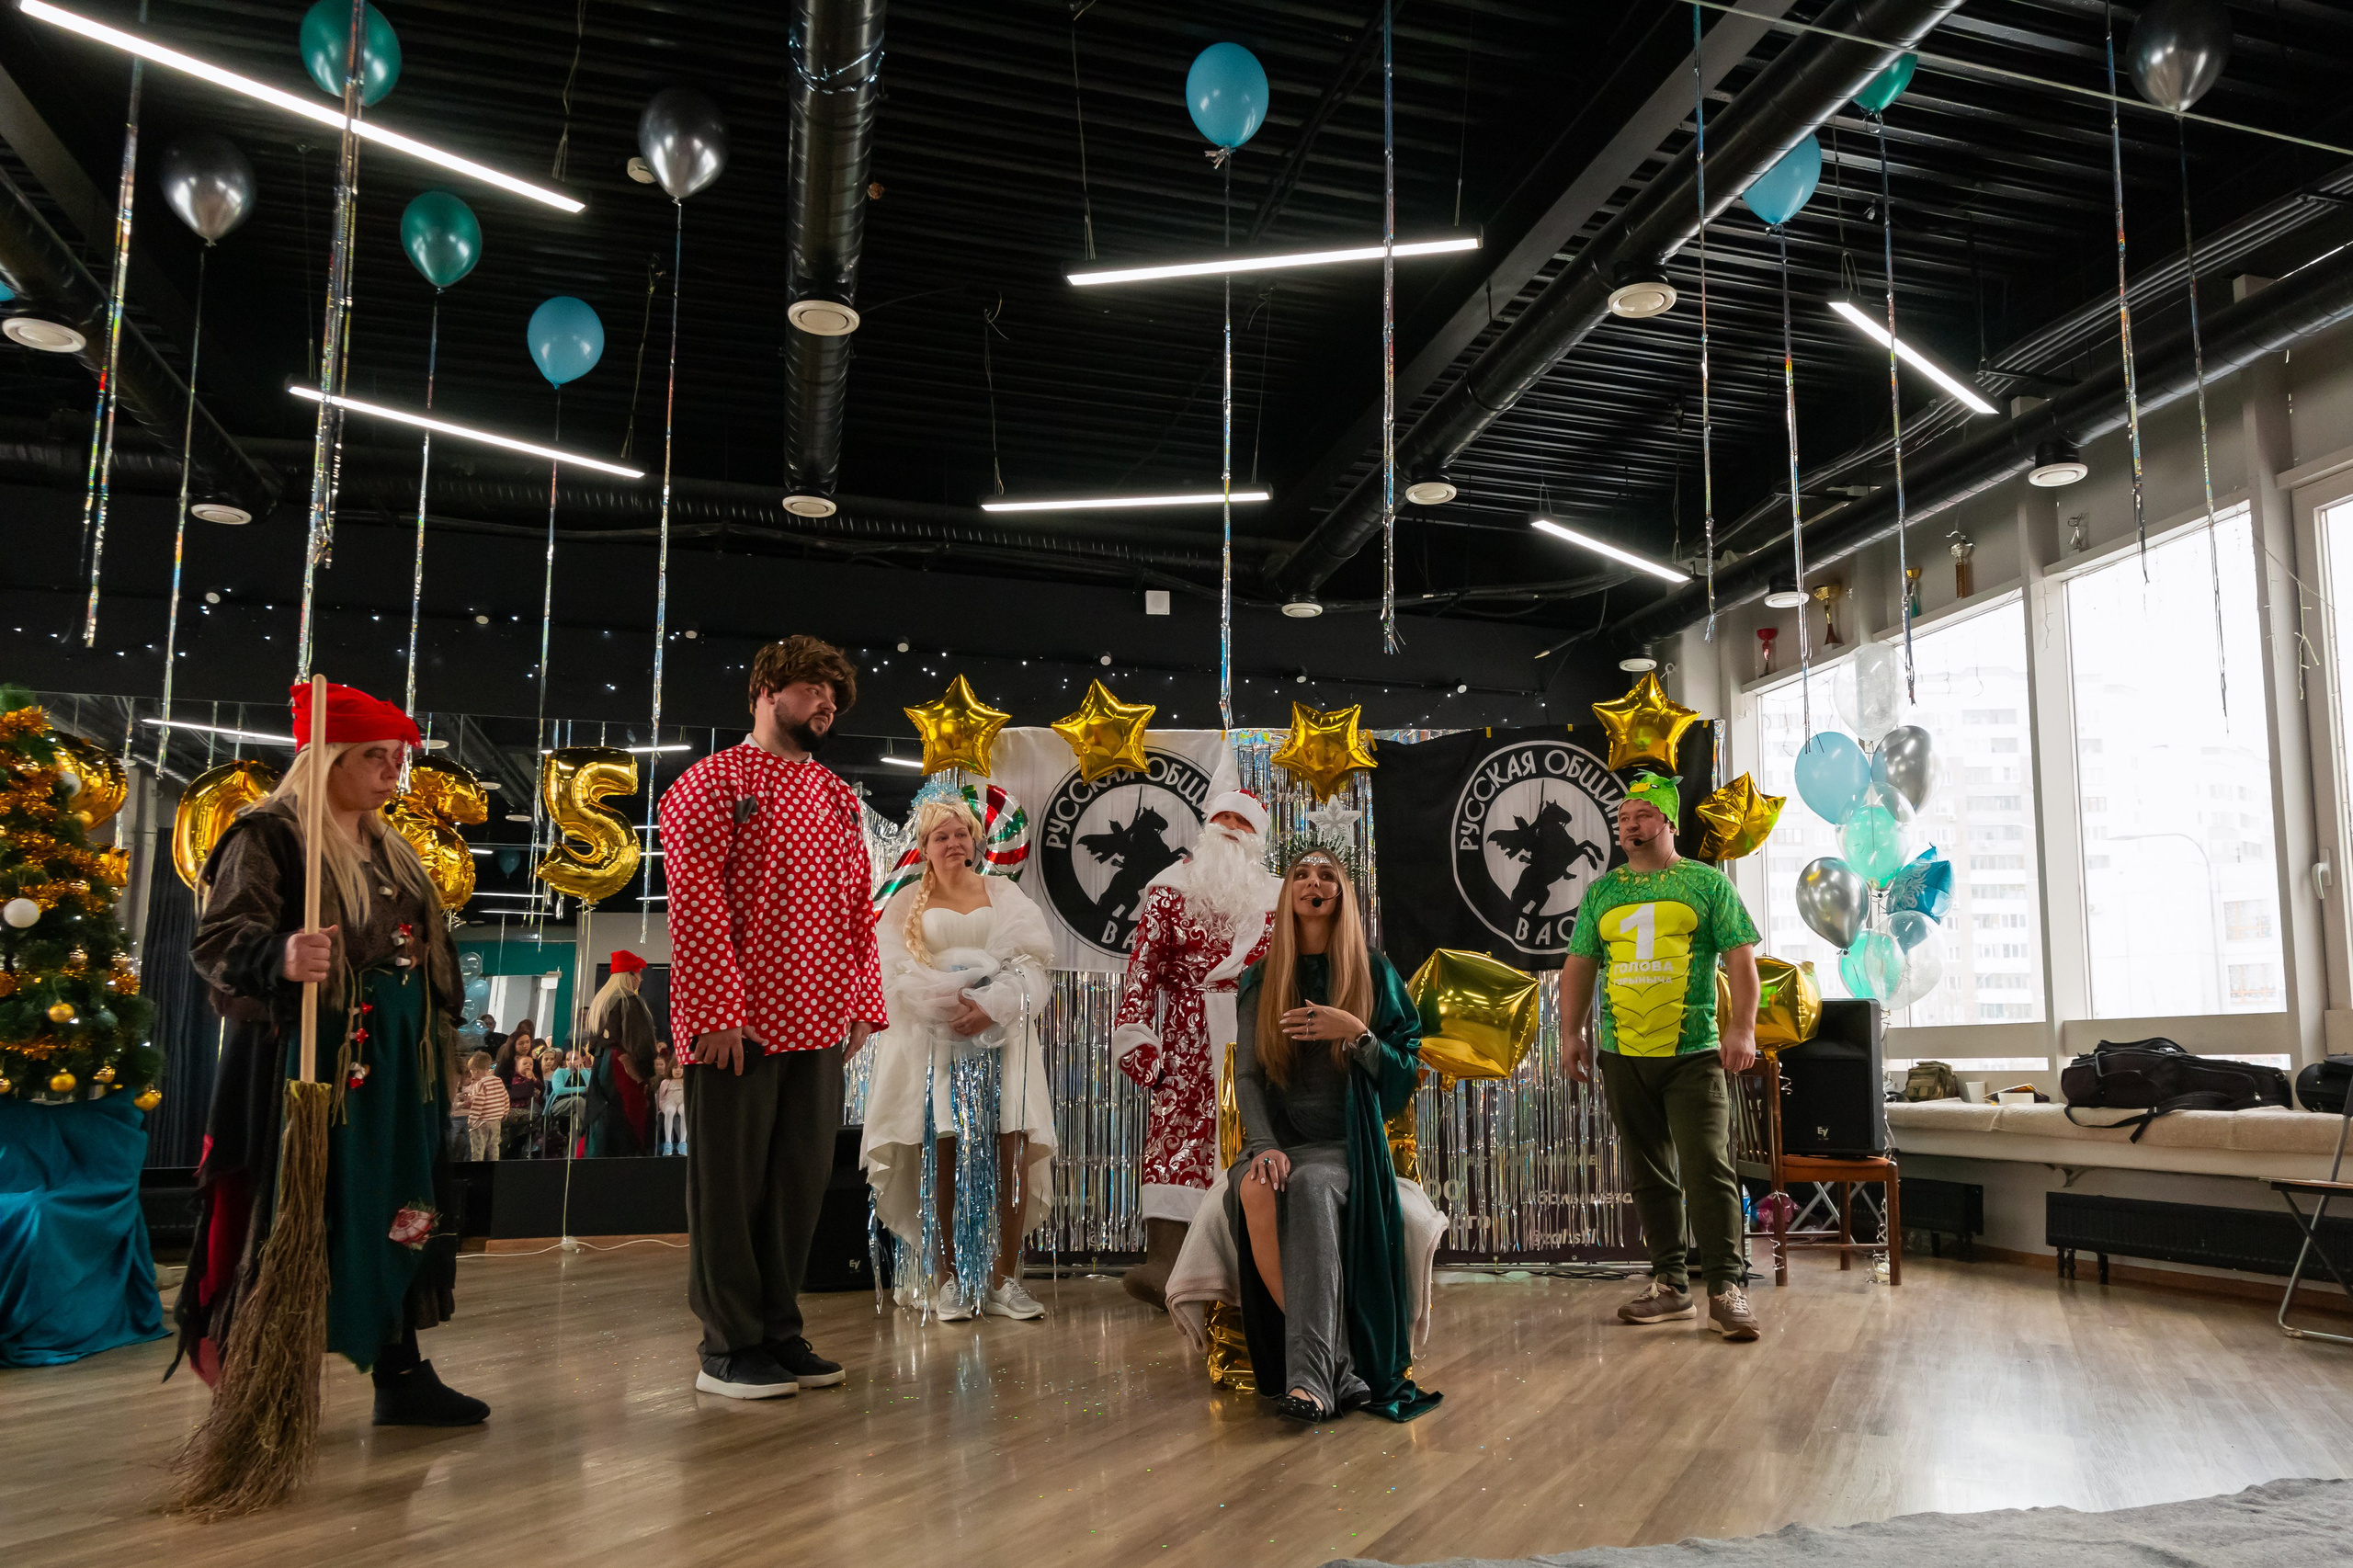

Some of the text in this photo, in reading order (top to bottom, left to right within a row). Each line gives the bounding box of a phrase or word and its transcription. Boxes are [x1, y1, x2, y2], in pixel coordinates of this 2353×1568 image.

[1460, 749, 1623, 850] РУССКАЯ ОБЩИ
[1101, 920, 1138, 949] ВА
[1620, 903, 1655, 960] 1
[1613, 960, 1673, 976] ГОЛОВА
[1613, 975, 1673, 986] ГОРЫНЫЧА
